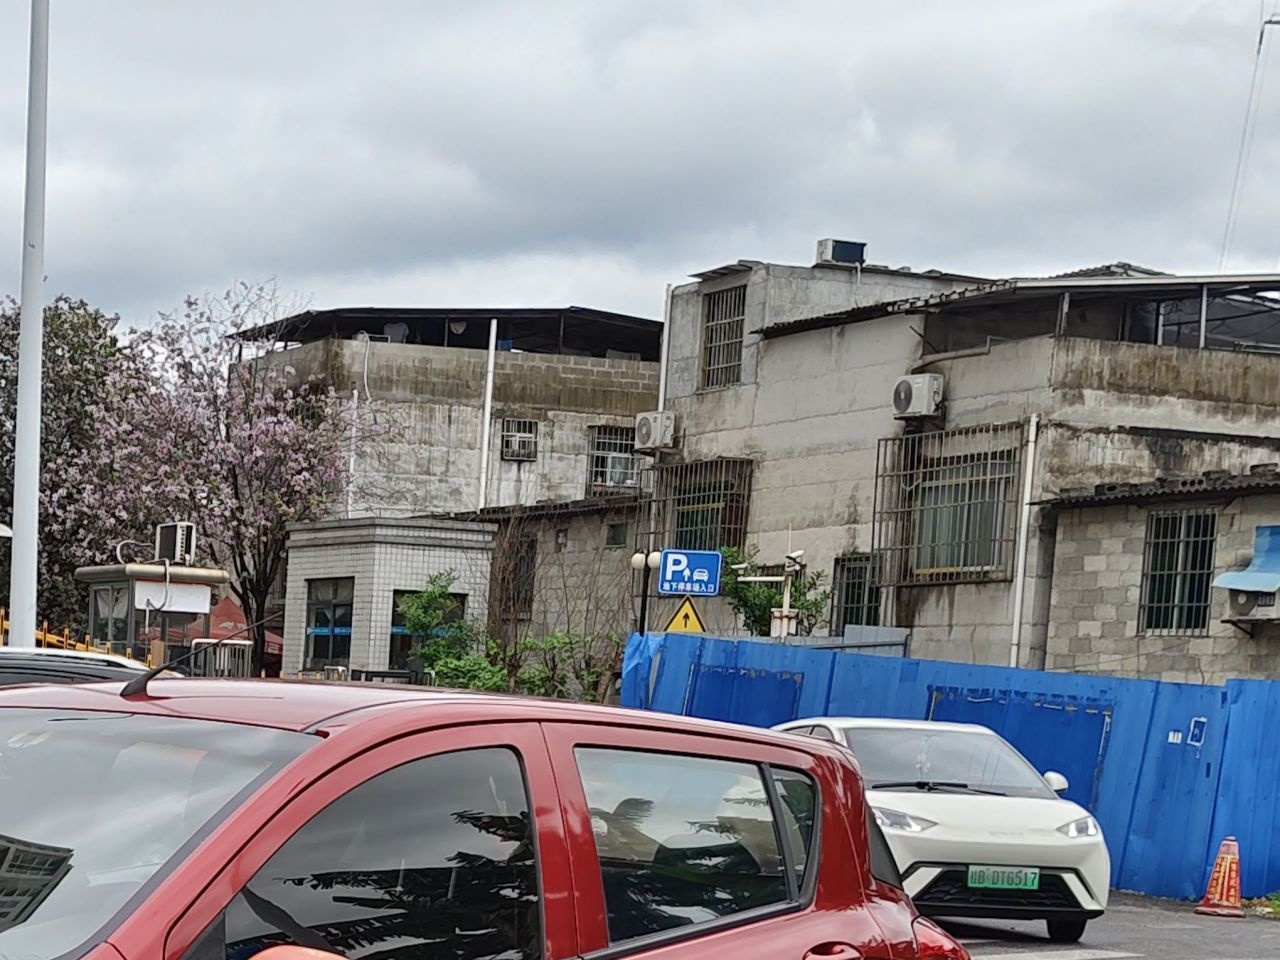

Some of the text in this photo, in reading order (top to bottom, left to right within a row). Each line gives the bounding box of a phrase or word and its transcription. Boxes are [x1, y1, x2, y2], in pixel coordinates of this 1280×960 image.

[665, 553, 688, 581] P
[662, 582, 714, 592] 地下停车场入口
